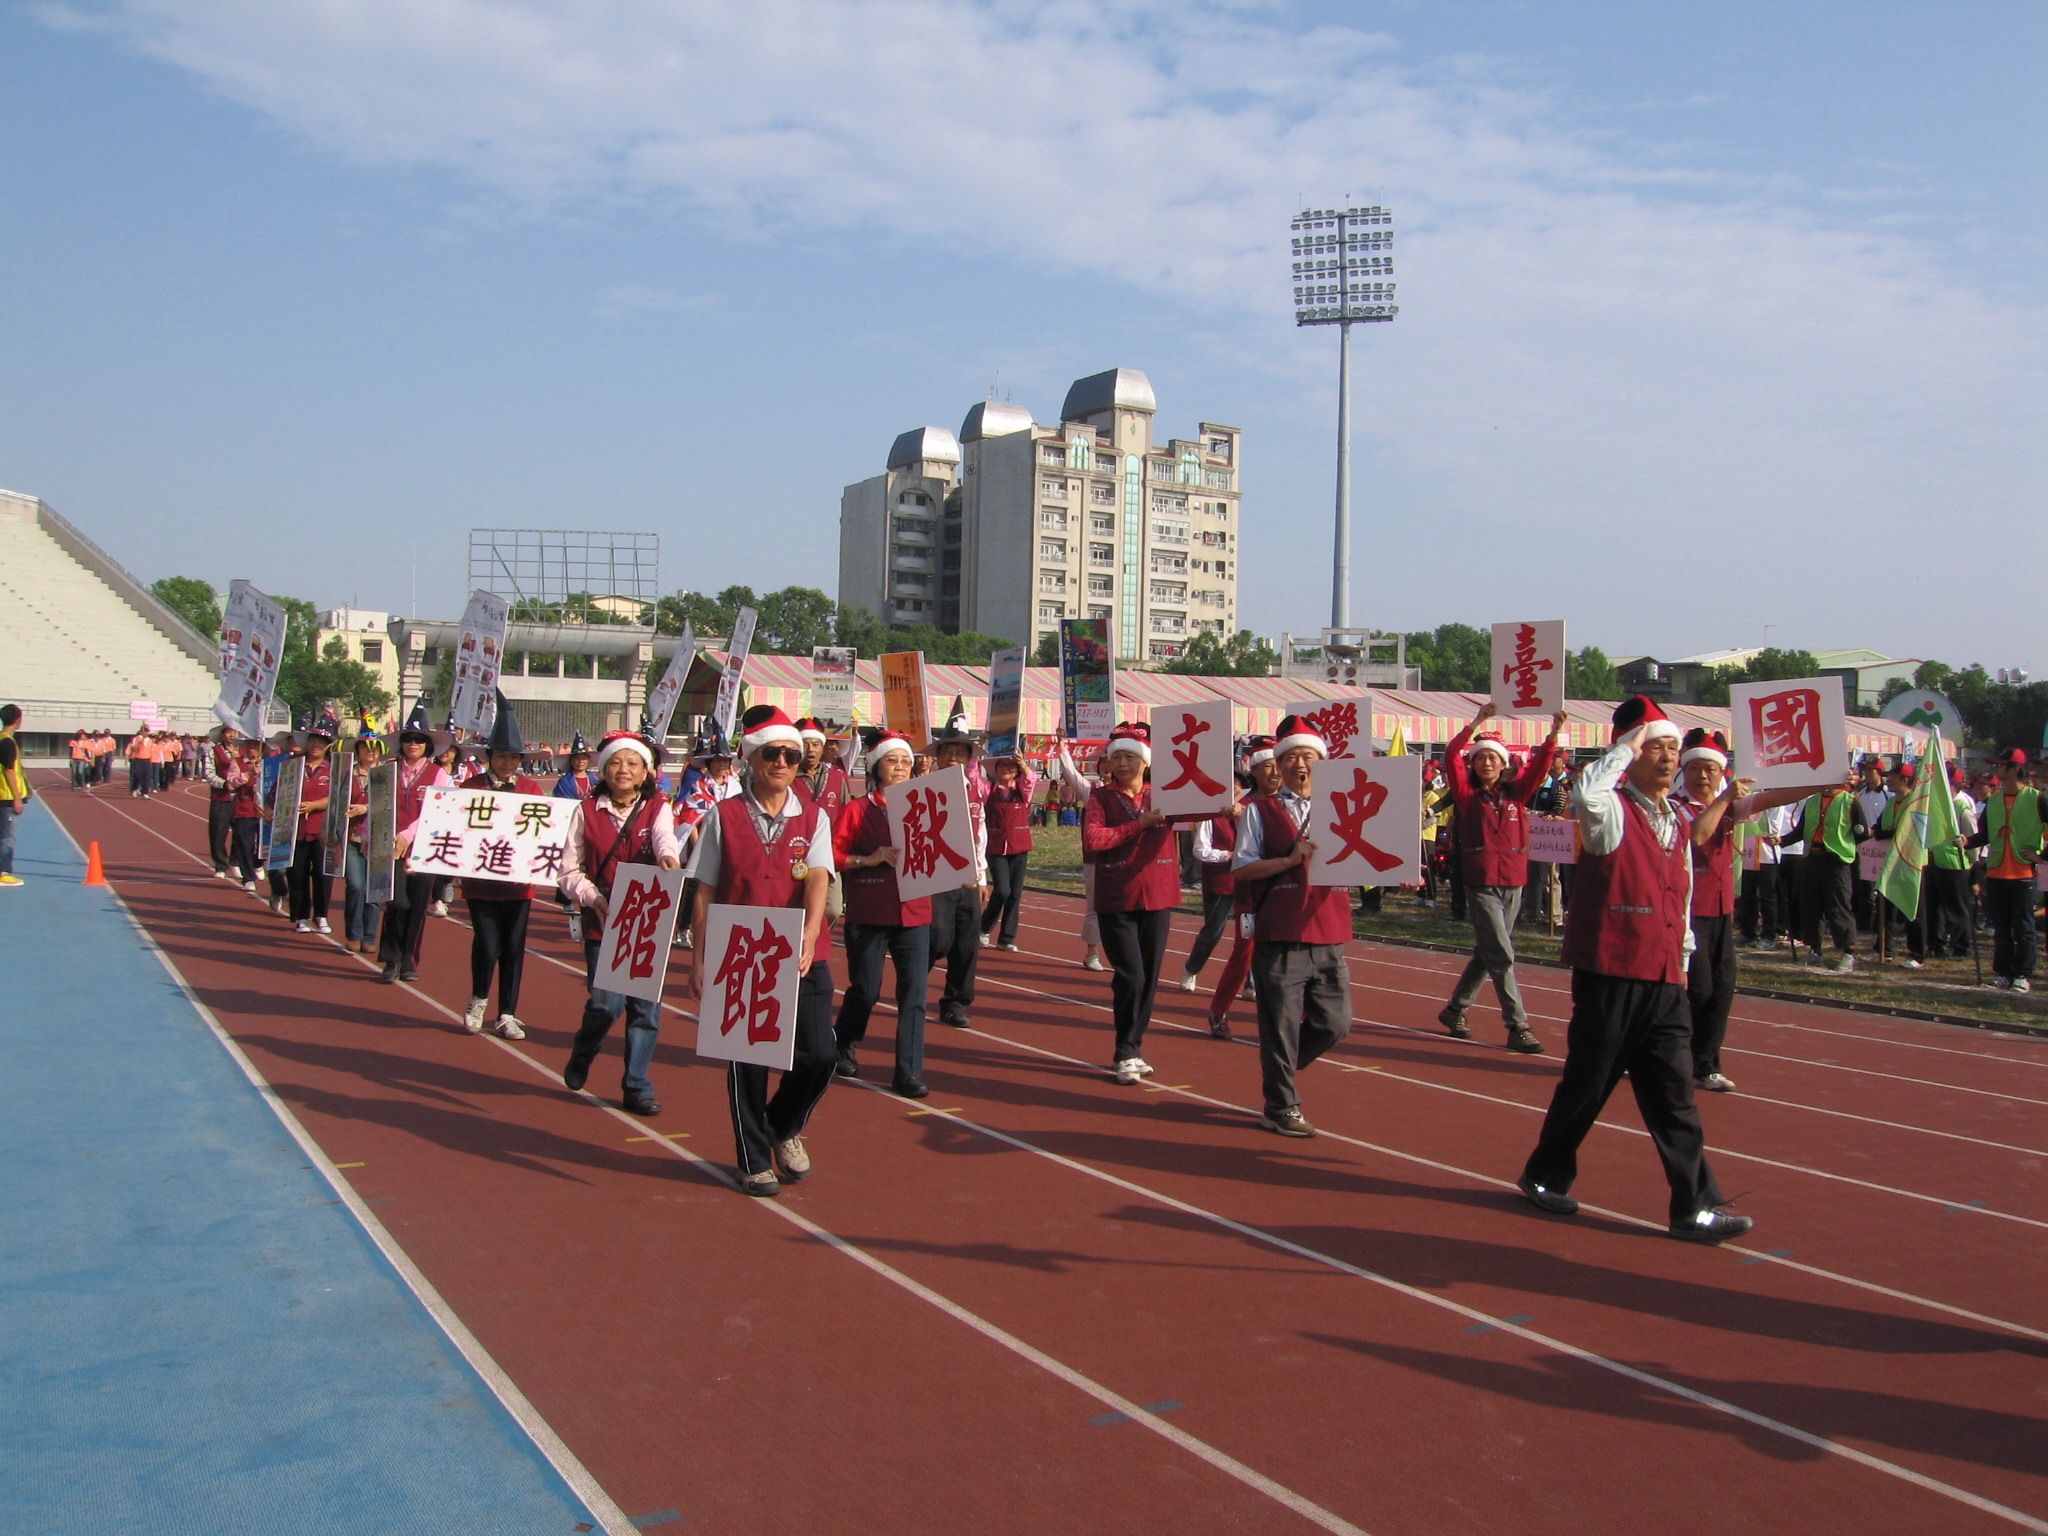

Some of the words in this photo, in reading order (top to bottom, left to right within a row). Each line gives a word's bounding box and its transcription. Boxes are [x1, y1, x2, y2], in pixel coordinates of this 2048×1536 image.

[1504, 624, 1555, 709] 臺
[1161, 713, 1229, 797] 文
[1750, 688, 1826, 770] 國
[425, 831, 564, 878] 走進來
[465, 795, 551, 837] 世界
[902, 785, 971, 880] 獻
[1326, 767, 1405, 873] 史
[611, 874, 671, 980] 館
[713, 917, 793, 1046] 館
